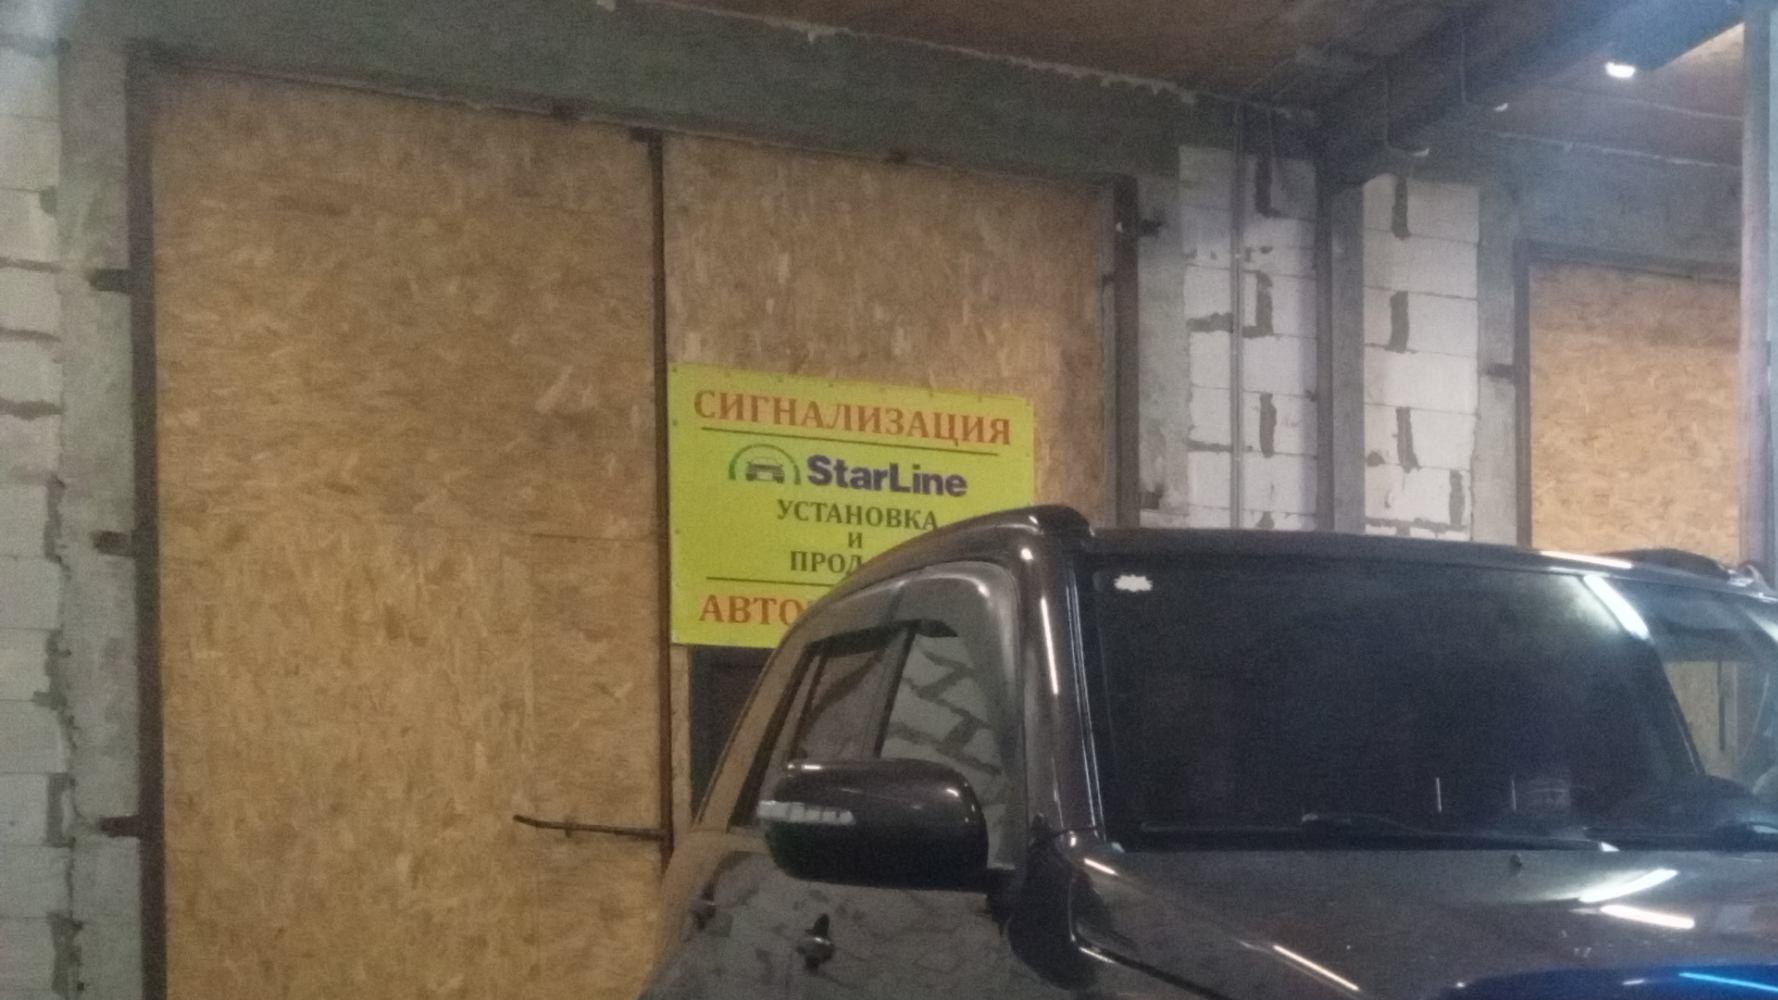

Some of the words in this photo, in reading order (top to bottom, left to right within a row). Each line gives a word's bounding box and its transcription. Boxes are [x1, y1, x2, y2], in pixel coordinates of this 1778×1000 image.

[693, 388, 1012, 446] СИГНАЛИЗАЦИЯ
[807, 454, 968, 497] StarLine
[777, 498, 938, 530] УСТАНОВКА
[848, 532, 863, 549] И
[698, 594, 812, 627] АВТО
